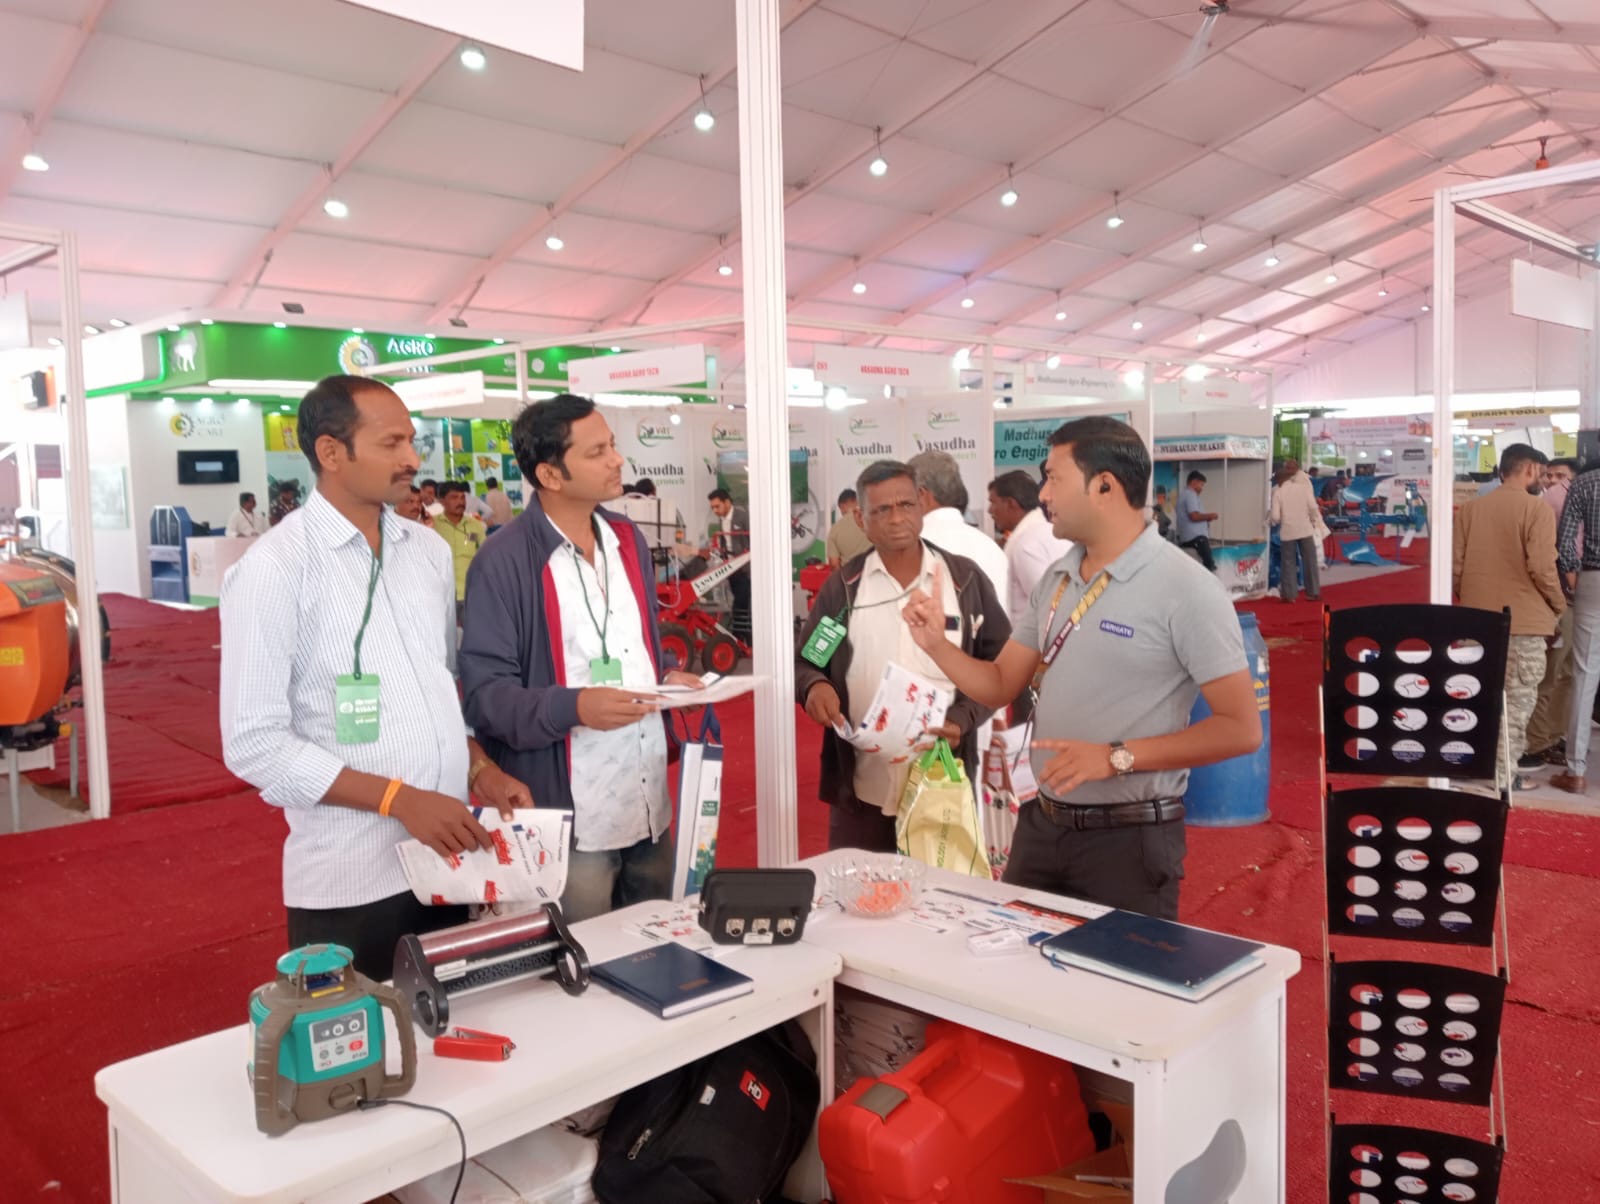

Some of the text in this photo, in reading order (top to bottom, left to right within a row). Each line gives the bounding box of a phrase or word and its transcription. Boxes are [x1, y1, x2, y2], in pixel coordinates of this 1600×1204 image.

[387, 337, 435, 356] AGRO
[1510, 408, 1545, 416] TOOLS
[838, 442, 893, 456] Vasudha
[916, 437, 976, 453] Vasudha
[631, 463, 684, 476] Vasudha
